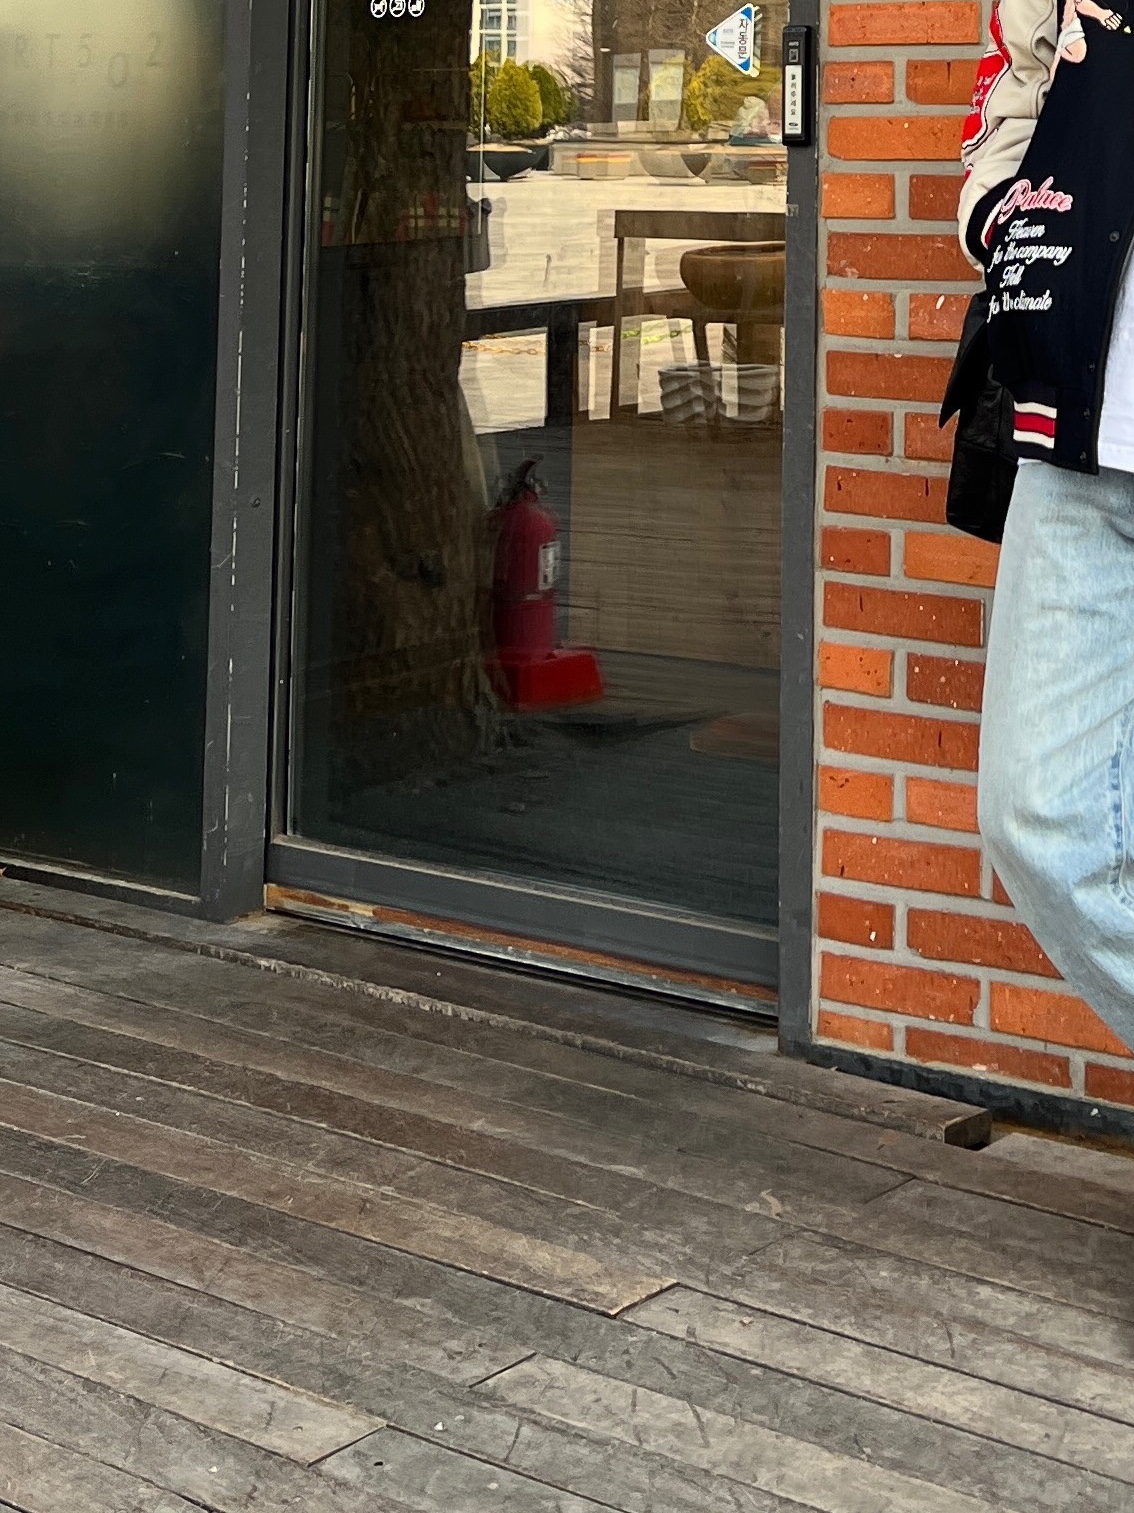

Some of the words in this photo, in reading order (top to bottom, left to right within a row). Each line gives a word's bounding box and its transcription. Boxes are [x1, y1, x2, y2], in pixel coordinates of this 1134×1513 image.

[737, 18, 749, 60] 자동문
[998, 176, 1074, 225] Palace
[1016, 245, 1073, 266] company
